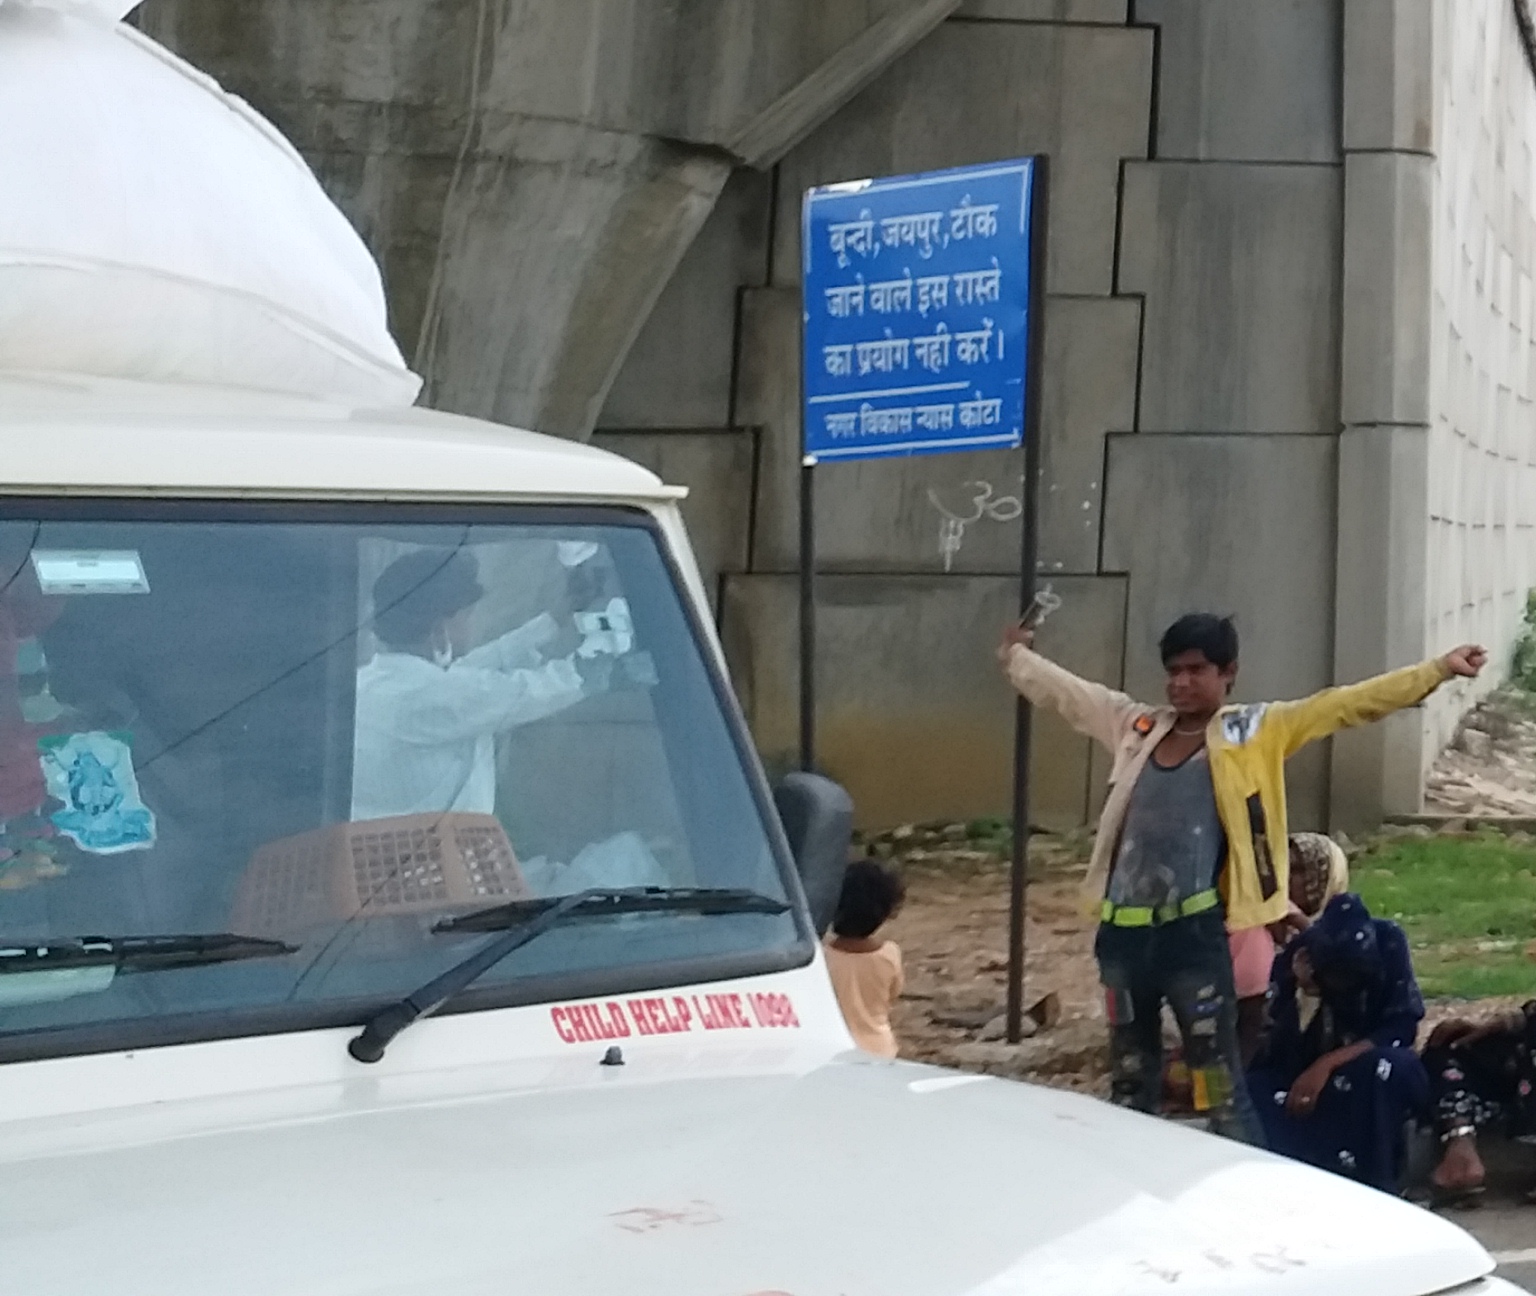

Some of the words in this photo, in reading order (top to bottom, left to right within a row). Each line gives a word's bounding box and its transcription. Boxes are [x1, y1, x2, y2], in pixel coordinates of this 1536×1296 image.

[825, 272, 865, 317] जाने
[869, 267, 913, 313] वाले
[917, 275, 950, 318] इस
[953, 256, 1001, 305] रास्ते
[823, 343, 854, 376] का
[856, 327, 911, 376] प्रयोग
[860, 402, 913, 436] विकास
[915, 404, 955, 431] न्यास
[959, 390, 1002, 430] कोटा
[550, 1001, 632, 1044] CHILD
[627, 995, 693, 1036] HELP
[691, 993, 751, 1030] LINE
